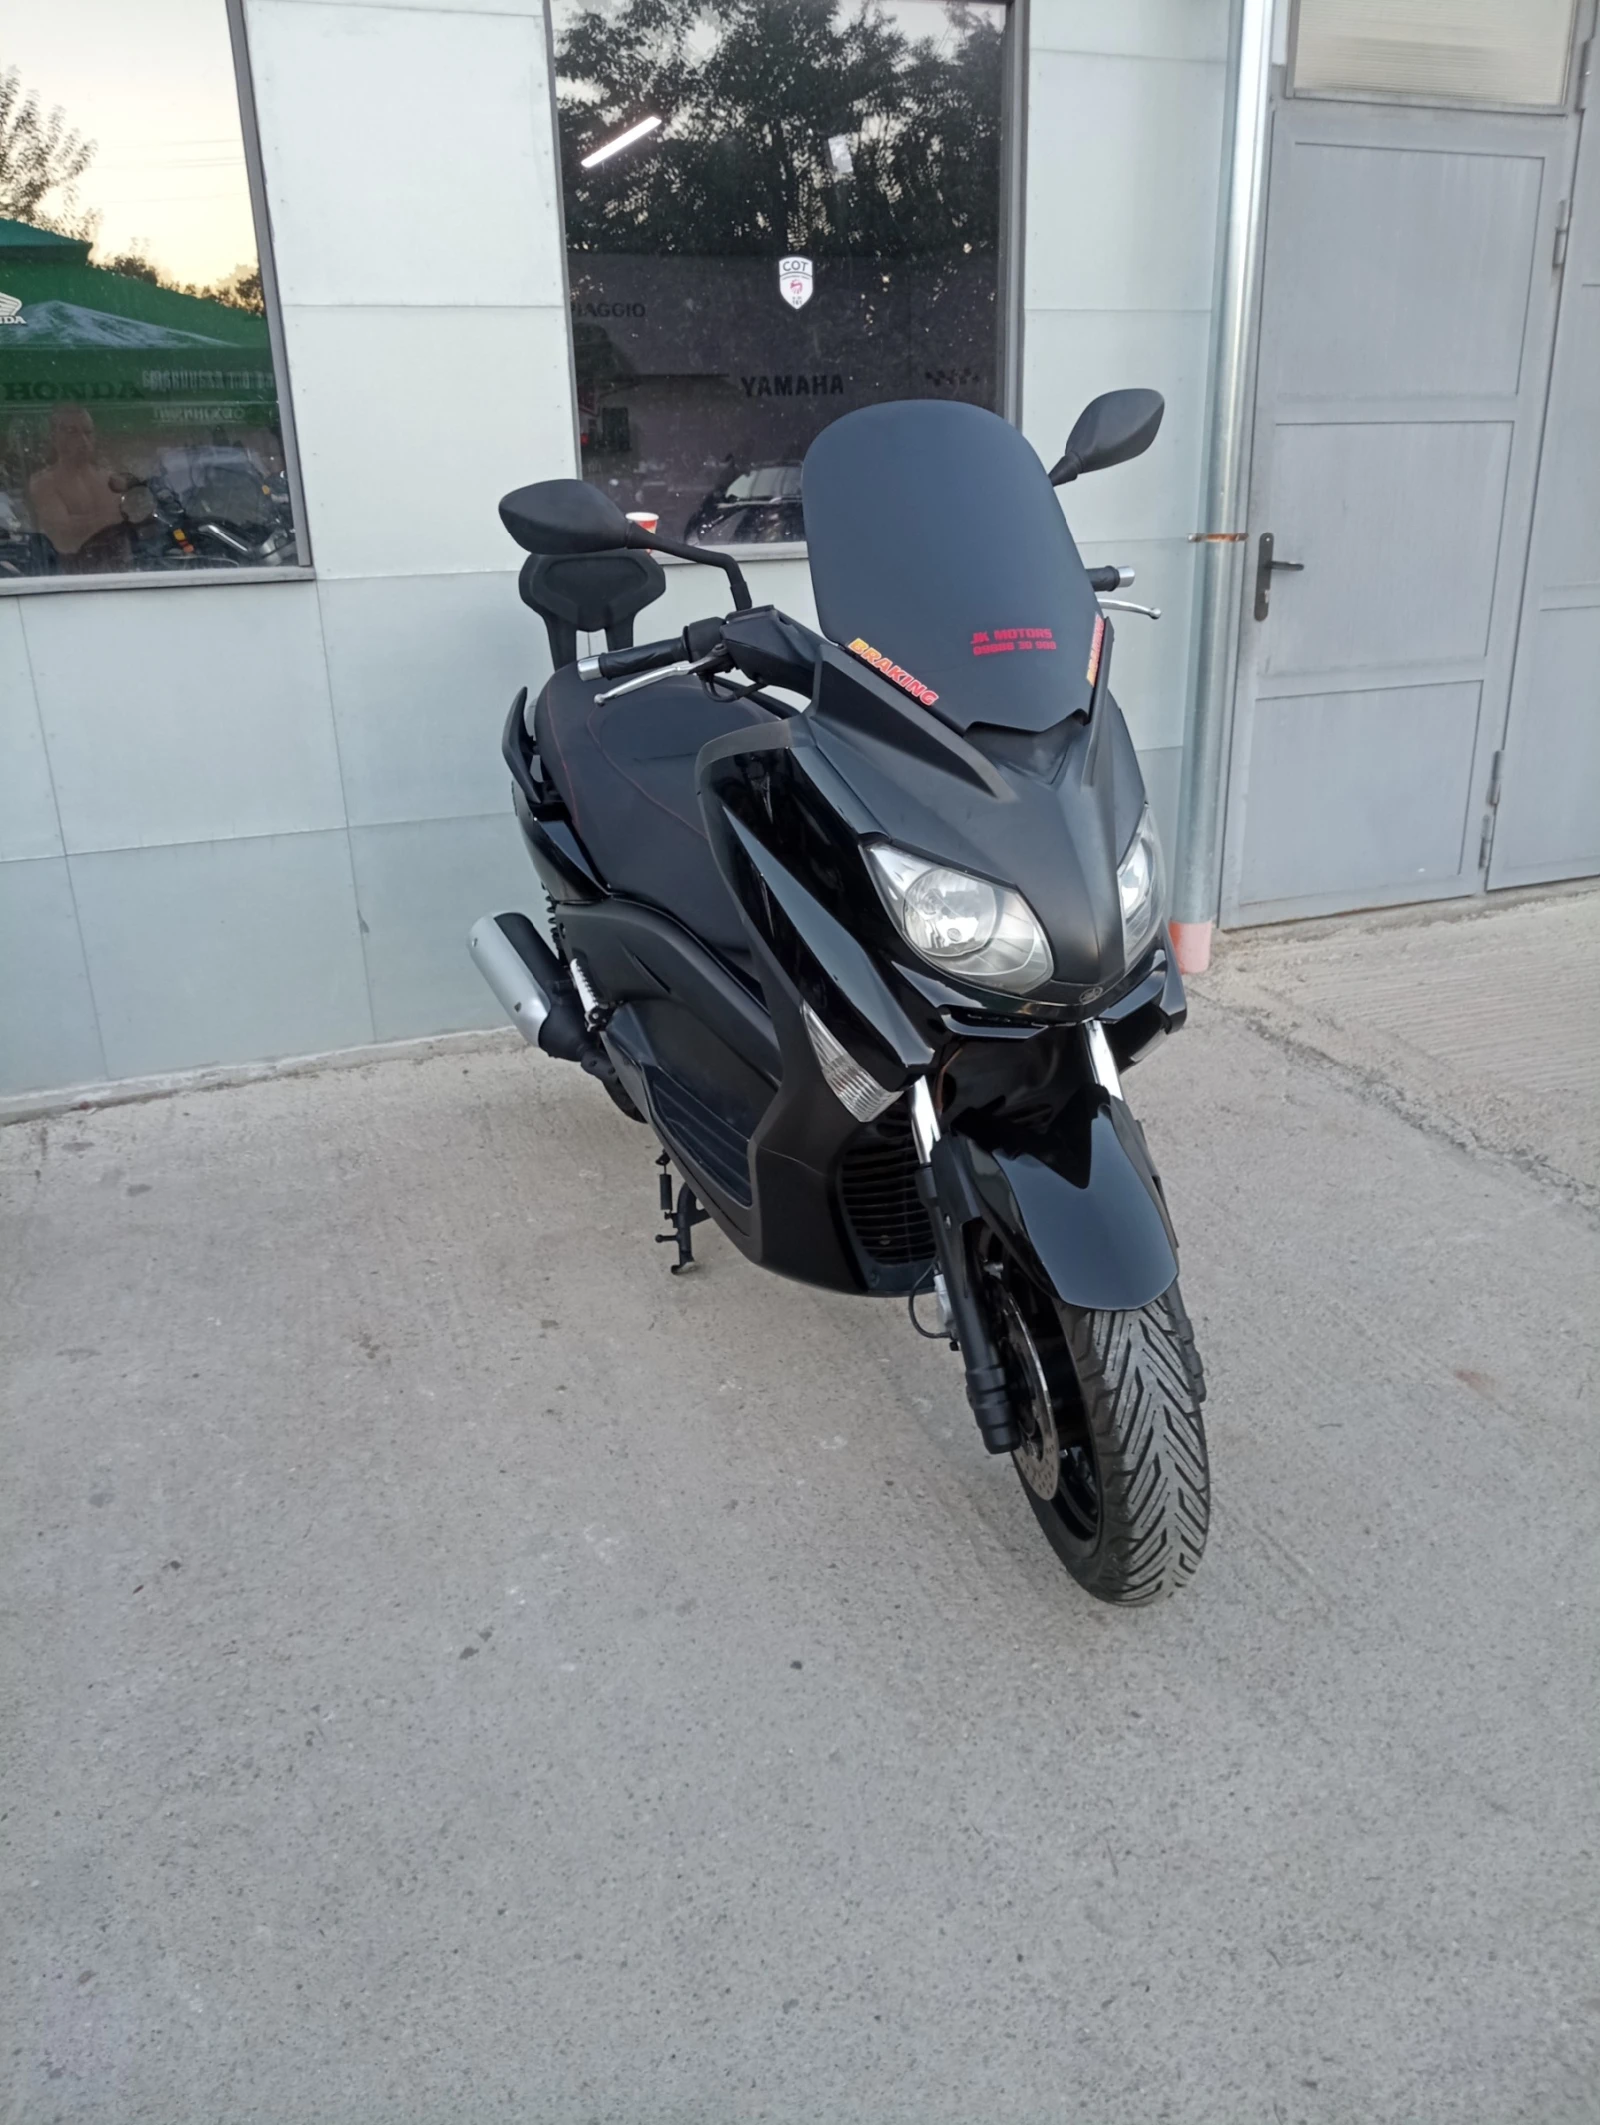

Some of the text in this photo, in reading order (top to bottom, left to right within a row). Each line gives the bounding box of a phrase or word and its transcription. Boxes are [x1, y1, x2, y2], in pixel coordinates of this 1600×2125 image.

[783, 260, 808, 271] COT
[4, 381, 145, 400] HONDA
[741, 375, 844, 397] YAMAHA
[994, 628, 1053, 640] MOTORS
[848, 637, 939, 706] BRAKING
